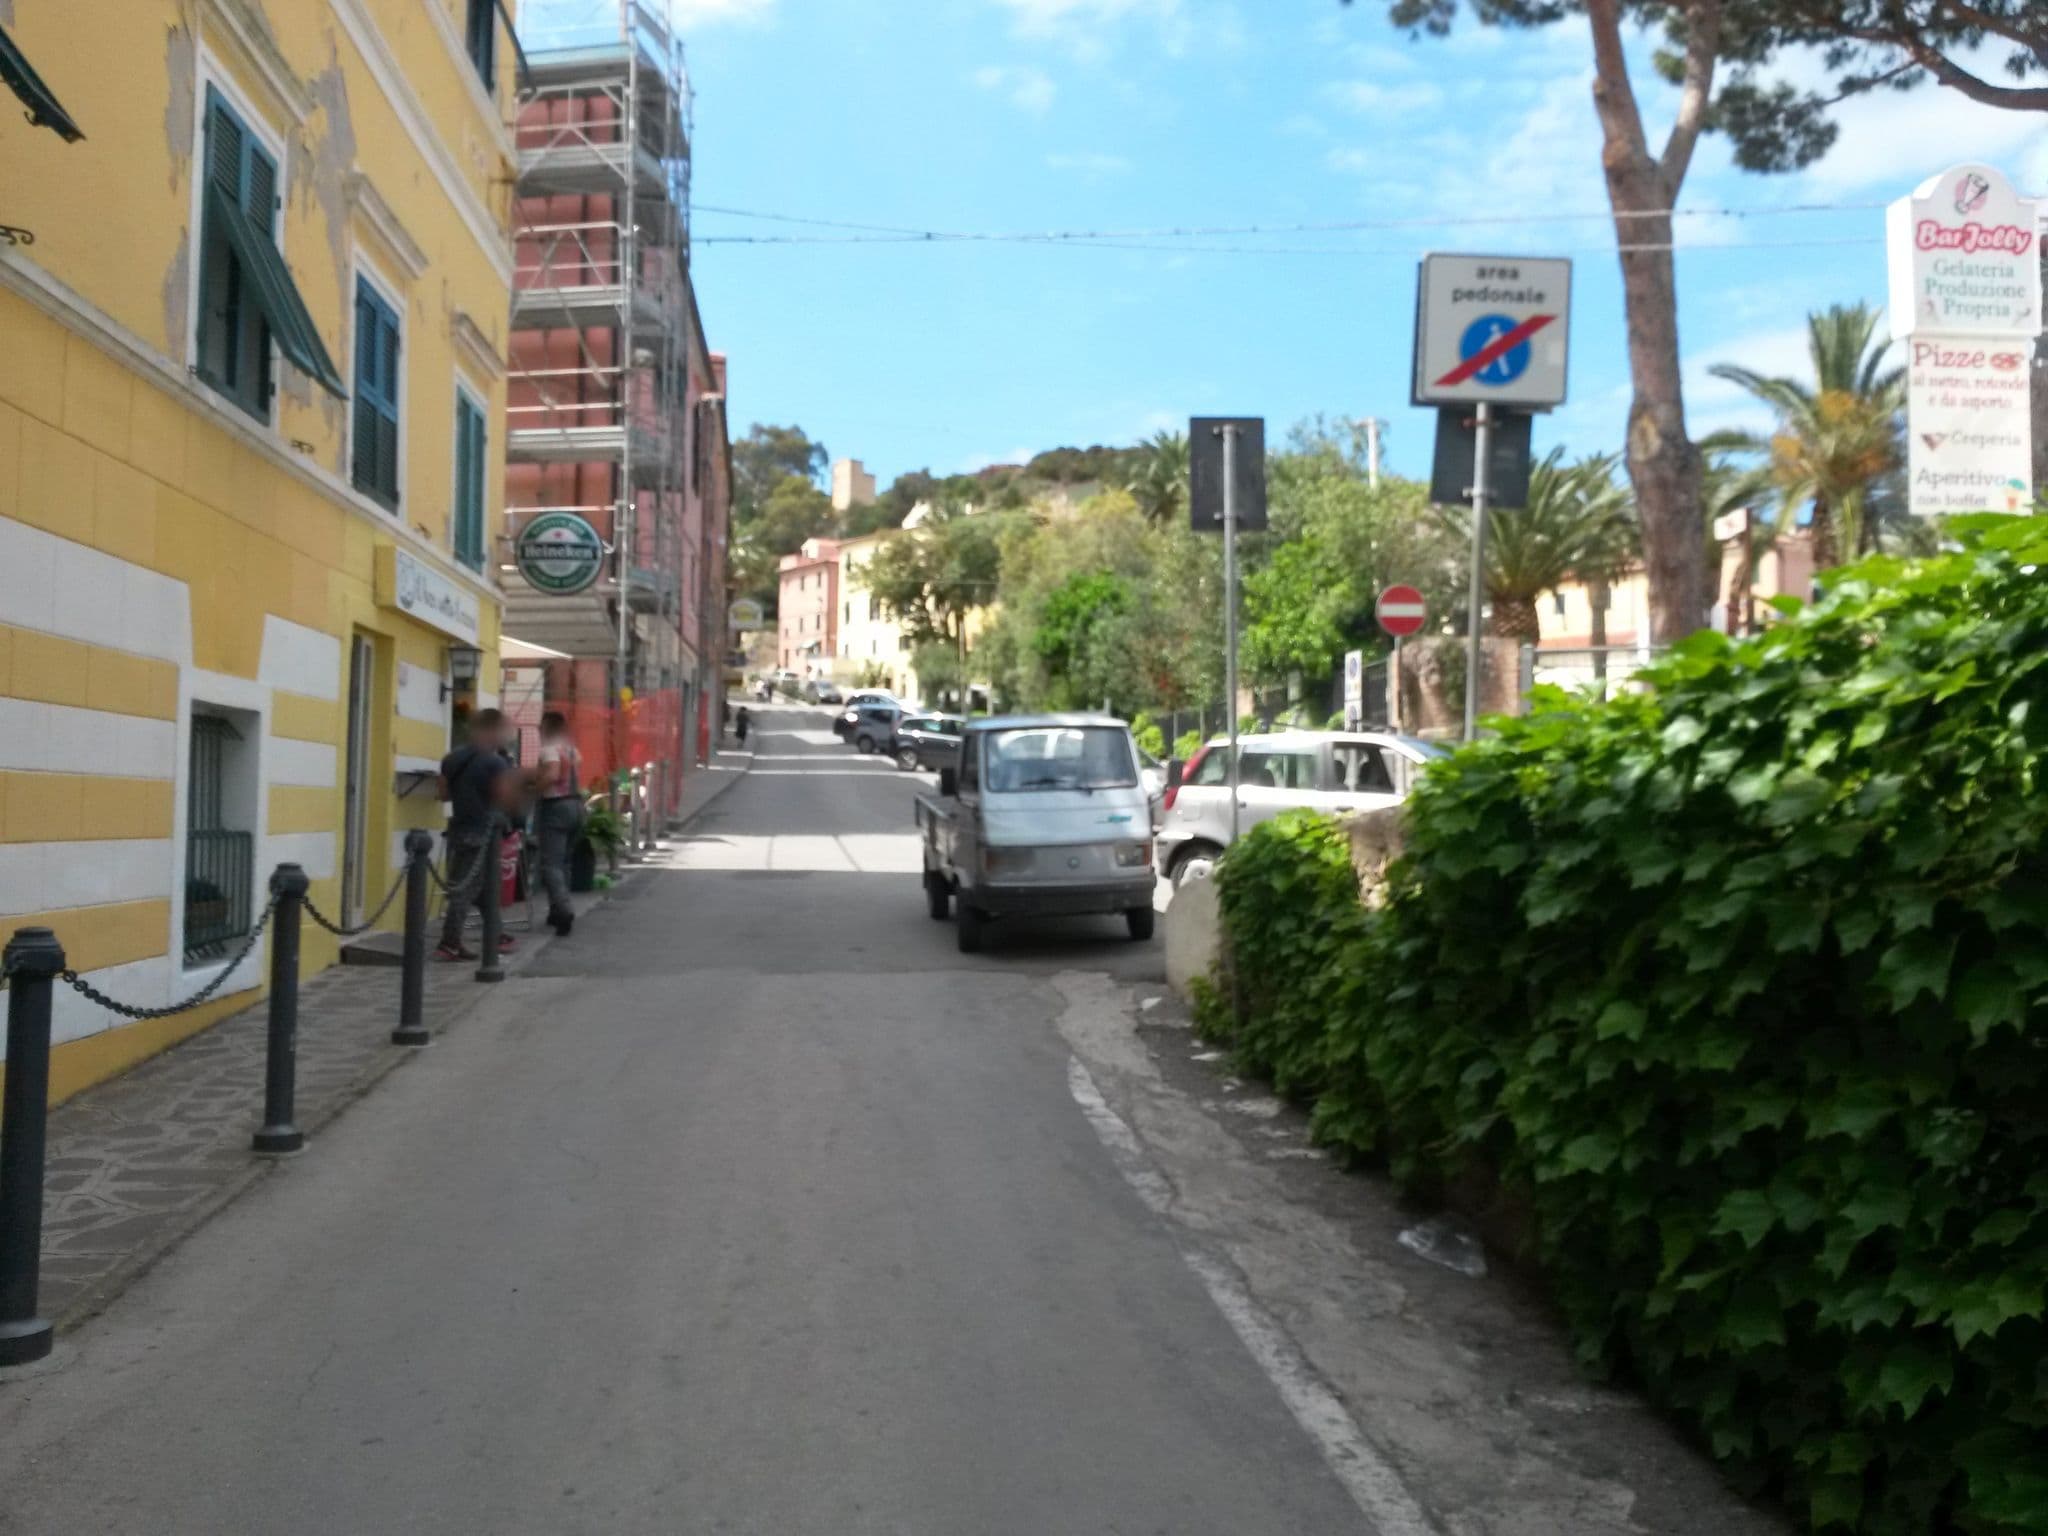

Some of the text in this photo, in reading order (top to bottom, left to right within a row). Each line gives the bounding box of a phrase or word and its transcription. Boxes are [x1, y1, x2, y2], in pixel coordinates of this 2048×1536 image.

[1916, 220, 2032, 254] Bar Jolly
[1476, 267, 1520, 280] area
[1933, 258, 2014, 278] Gelateria
[1451, 286, 1545, 304] pedonale
[1924, 277, 2026, 298] Produzione
[1943, 300, 2010, 320] Propria
[1913, 343, 1985, 368] Pizze
[1950, 430, 2021, 449] Creperia
[1916, 467, 2006, 488] Aperitivo
